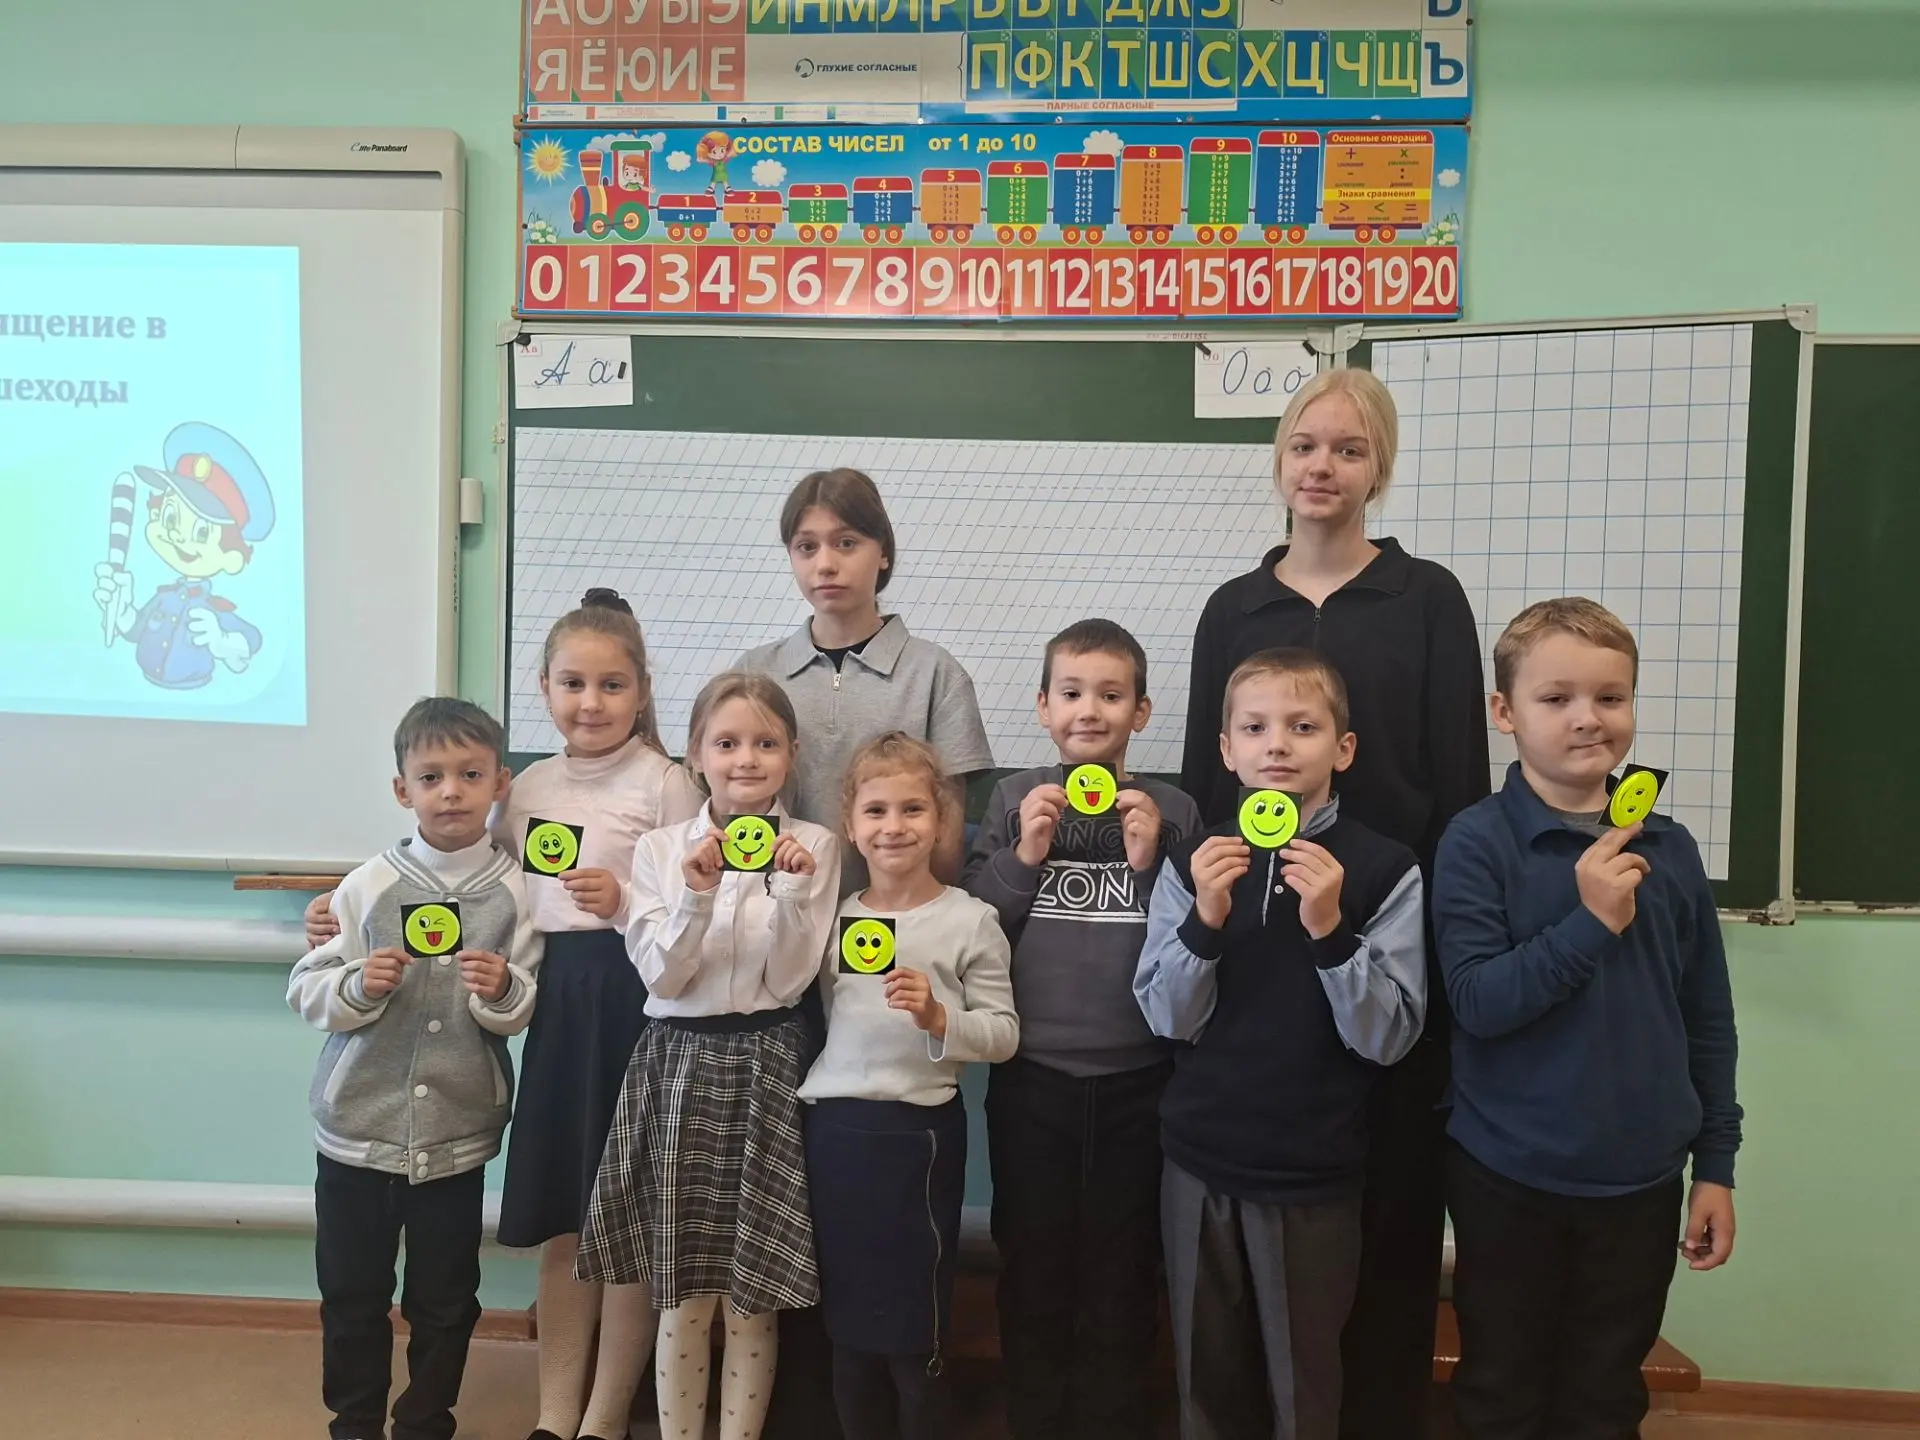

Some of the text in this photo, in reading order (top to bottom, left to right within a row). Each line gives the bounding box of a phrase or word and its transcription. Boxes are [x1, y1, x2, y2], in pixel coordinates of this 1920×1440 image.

[535, 38, 735, 92] Я Ё Ю И Е
[816, 63, 918, 72] ГЛУХИЕ СОГЛАСНЫЕ
[971, 41, 1464, 94] П Ф К Т Ш С Х Ц Ч Щ Ъ
[1046, 101, 1155, 110] ПАРНЫЕ СОГЛАСНЫЕ
[733, 133, 1036, 154] СОСТАВ ЧИСЕЛ от 1 до 10
[1282, 133, 1297, 144] 10
[1332, 133, 1427, 144] Основные операции
[1216, 140, 1225, 151] 9
[1149, 147, 1157, 158] 8
[1081, 155, 1090, 166] 7
[1014, 163, 1022, 174] 6
[947, 171, 954, 181] 5
[878, 179, 887, 190] 4
[814, 185, 822, 196] 3
[1338, 190, 1416, 199] Знаки сравнения
[684, 196, 690, 206] 1
[750, 192, 757, 202] 2
[530, 253, 1456, 308] 0 1 2 3 4 5 6 7 8 9 10 11 12 13 14 15 16 17 18 19 20
[146, 316, 167, 339] в
[1034, 867, 1147, 912] ZON
